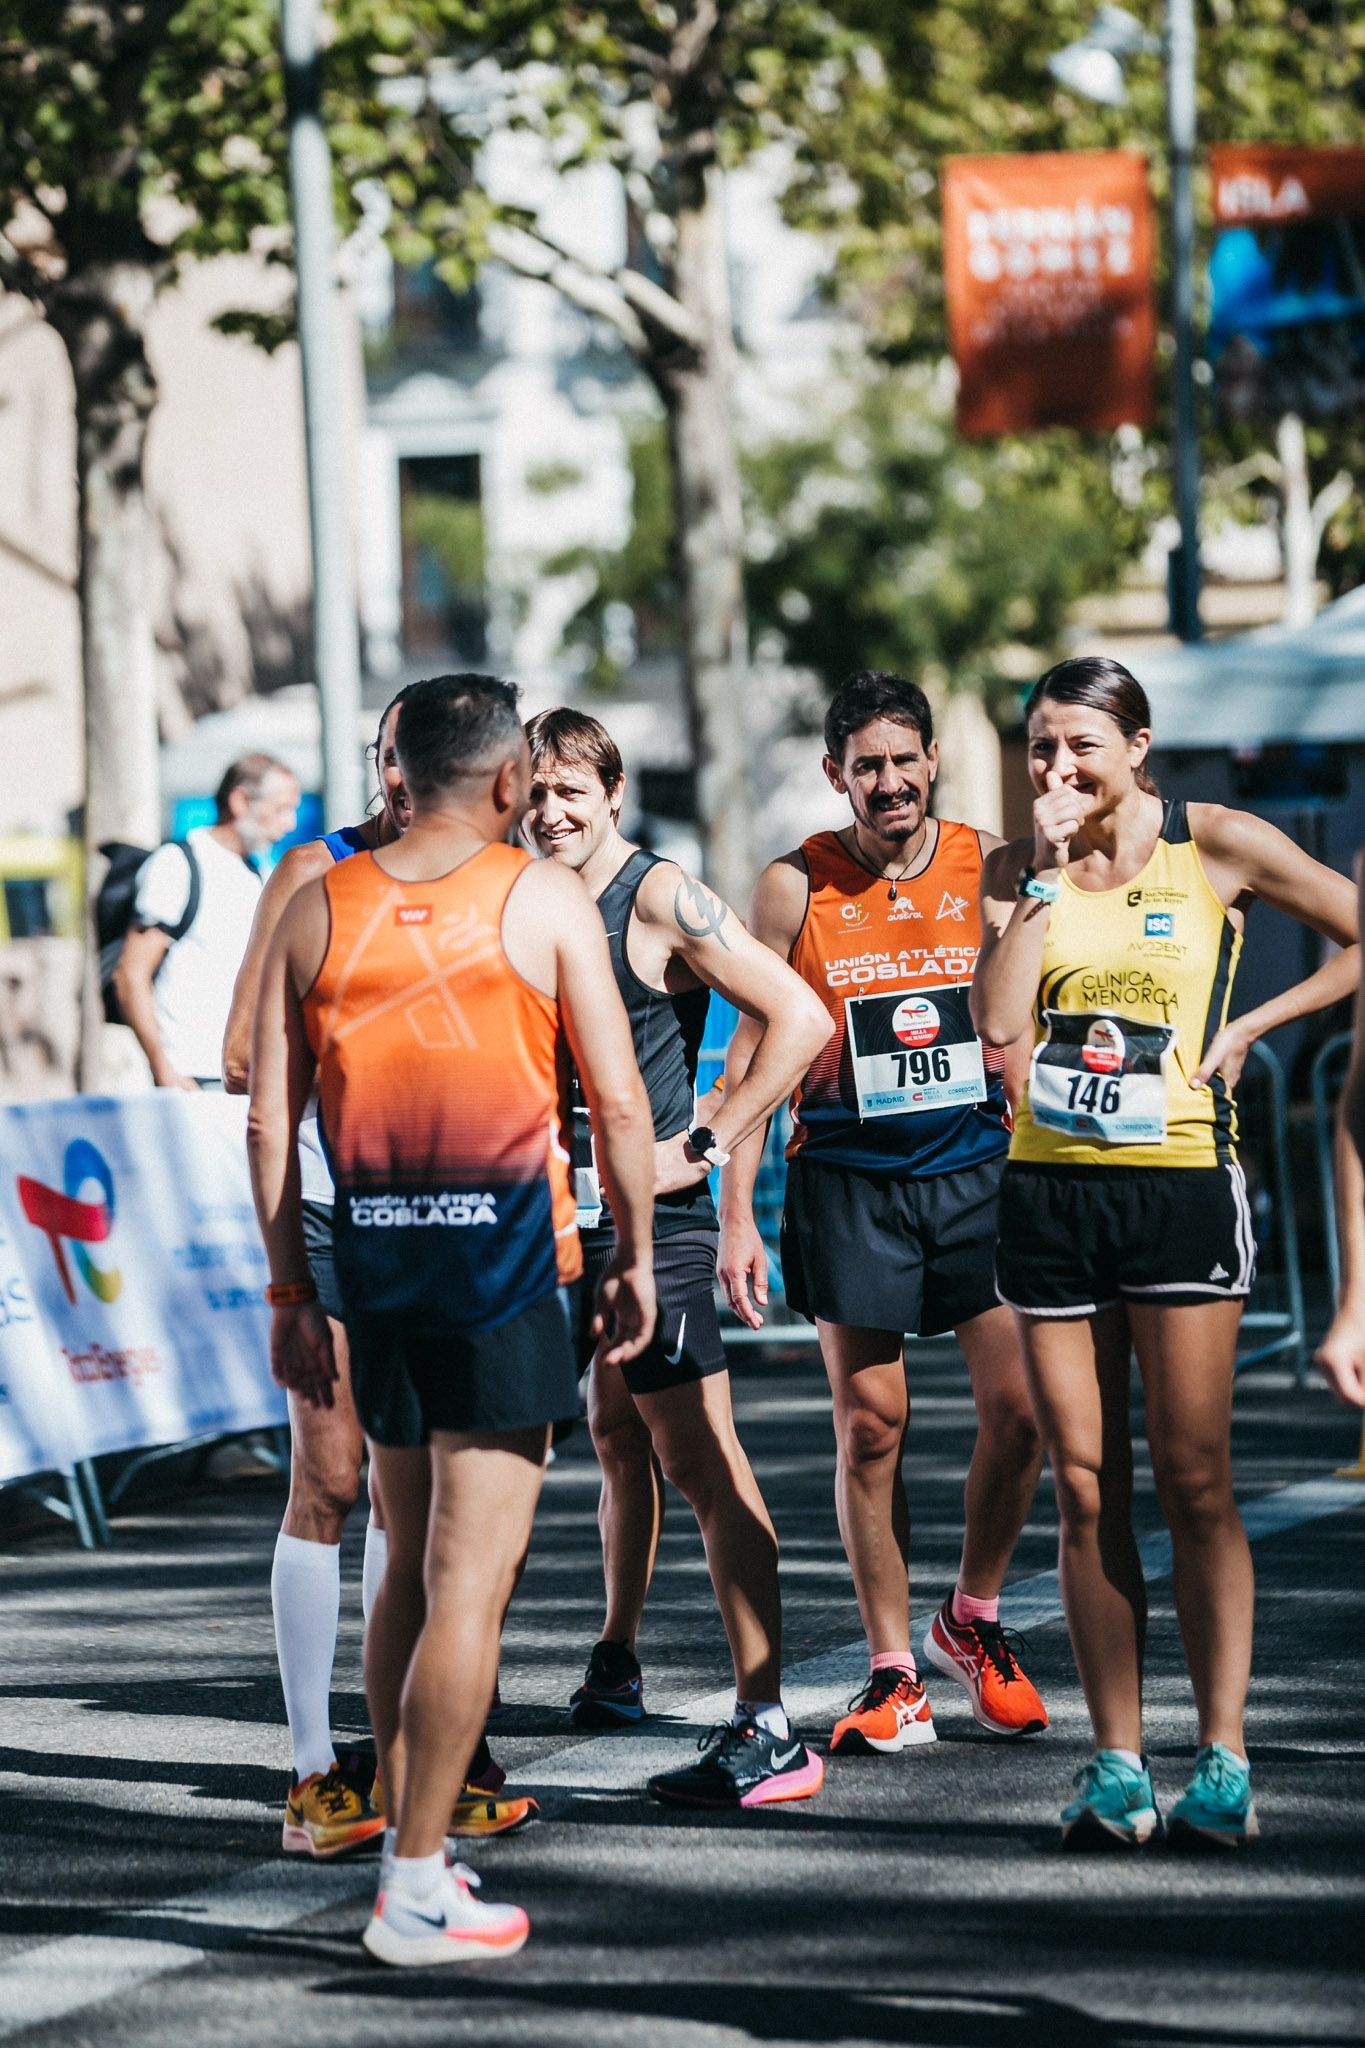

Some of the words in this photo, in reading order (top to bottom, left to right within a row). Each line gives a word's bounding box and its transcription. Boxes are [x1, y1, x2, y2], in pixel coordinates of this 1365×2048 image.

[825, 951, 891, 971] UNIÓN
[1083, 987, 1180, 1010] MENORCA
[891, 1047, 951, 1088] 796
[875, 1095, 905, 1106] MADRID
[1068, 1074, 1120, 1114] 146
